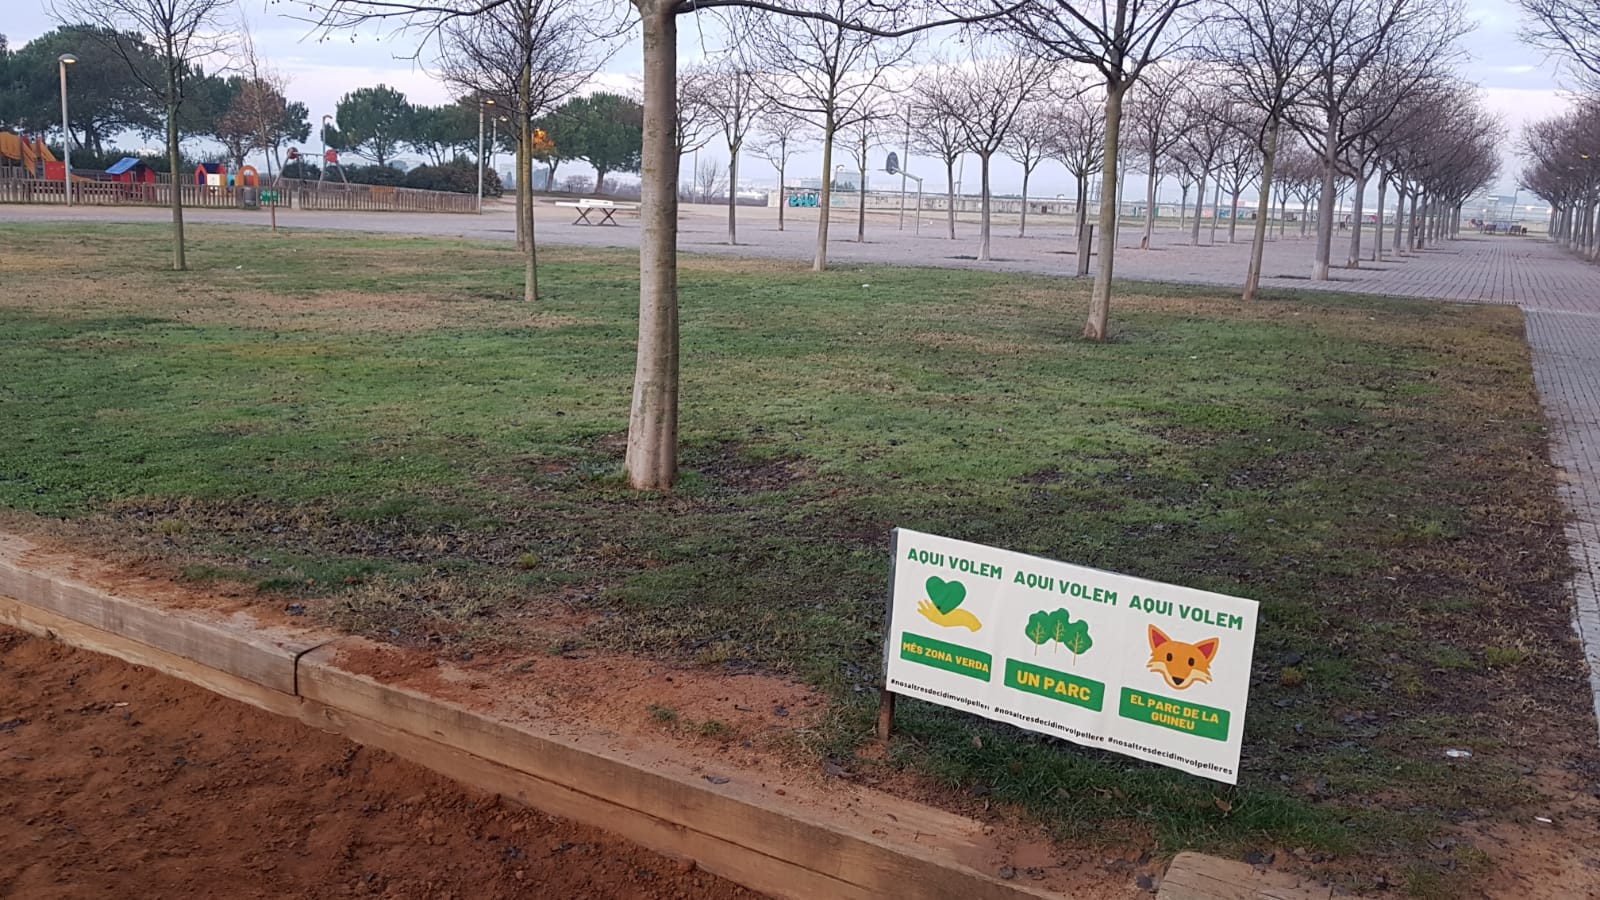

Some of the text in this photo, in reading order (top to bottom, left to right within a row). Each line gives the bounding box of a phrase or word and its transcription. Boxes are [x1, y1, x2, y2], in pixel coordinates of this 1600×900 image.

[908, 548, 1002, 580] AQUI VOLEM
[1014, 571, 1117, 605] AQUI VOLEM
[1129, 595, 1243, 630] AQUI VOLEM
[903, 642, 989, 673] MÉS ZONA VERDA
[1017, 670, 1091, 701] UN PARC
[1130, 694, 1219, 725] EL PARC DE LA
[1152, 711, 1196, 730] GUINEU
[1108, 737, 1233, 775] #nosaltresdecidimvolpelleres
